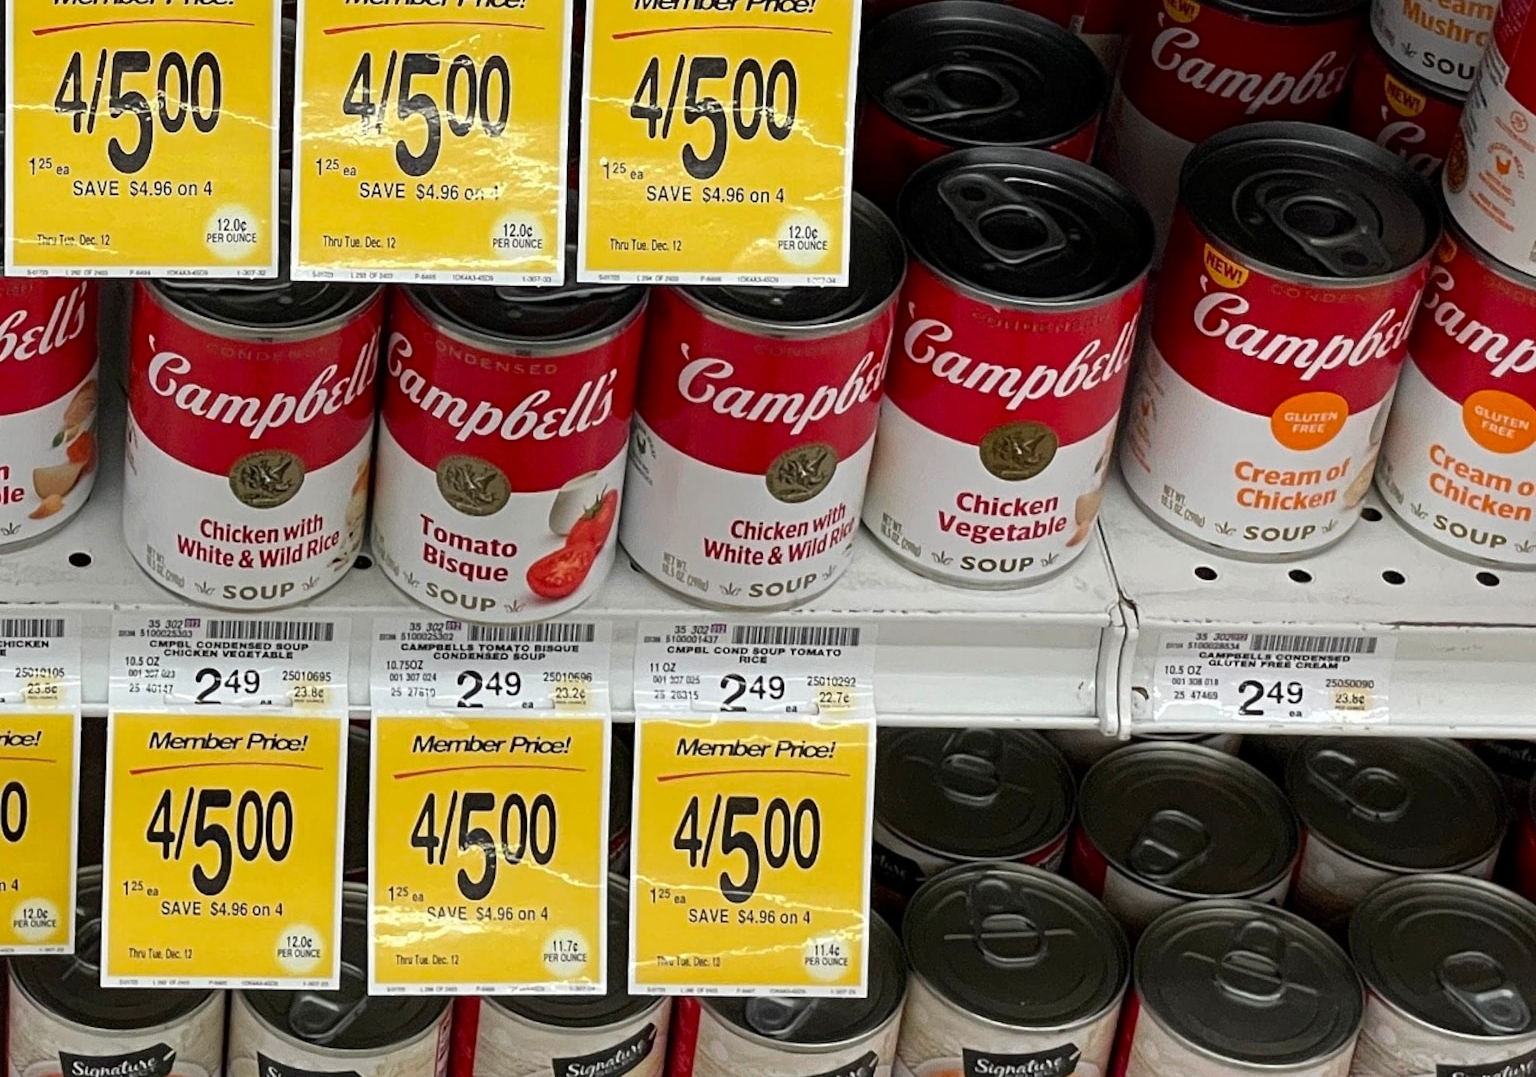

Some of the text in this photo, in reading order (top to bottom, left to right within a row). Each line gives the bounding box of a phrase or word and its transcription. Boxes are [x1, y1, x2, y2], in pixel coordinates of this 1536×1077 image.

[1387, 81, 1422, 110] NEW!
[778, 241, 827, 250] PER OUNCE
[1205, 251, 1244, 284] NEW!
[387, 332, 617, 441] Campbell's
[1284, 411, 1338, 425] GLUTEN
[1292, 423, 1325, 433] FREE
[1234, 459, 1350, 486] Cream of
[957, 493, 1058, 517] Chicken
[1236, 487, 1336, 511] Chicken
[199, 513, 324, 545] Chicken with
[420, 514, 517, 558] Tomato
[938, 511, 1067, 545] Vegetable
[1244, 524, 1316, 542] SOUP
[177, 528, 339, 569] White & Wild Rice
[423, 544, 508, 586] Bisque
[961, 556, 1034, 573] SOUP
[223, 581, 295, 601] SOUP
[426, 582, 496, 612] SOUP
[401, 644, 579, 653] CAMPBELLS TOMATO BISQUE
[1199, 652, 1350, 662] CAMPBELLS CONDENSED
[1208, 660, 1256, 668] GLUTEN
[1295, 662, 1338, 670] CREAM
[677, 740, 835, 759] Member Price!
[12, 878, 19, 891] 4
